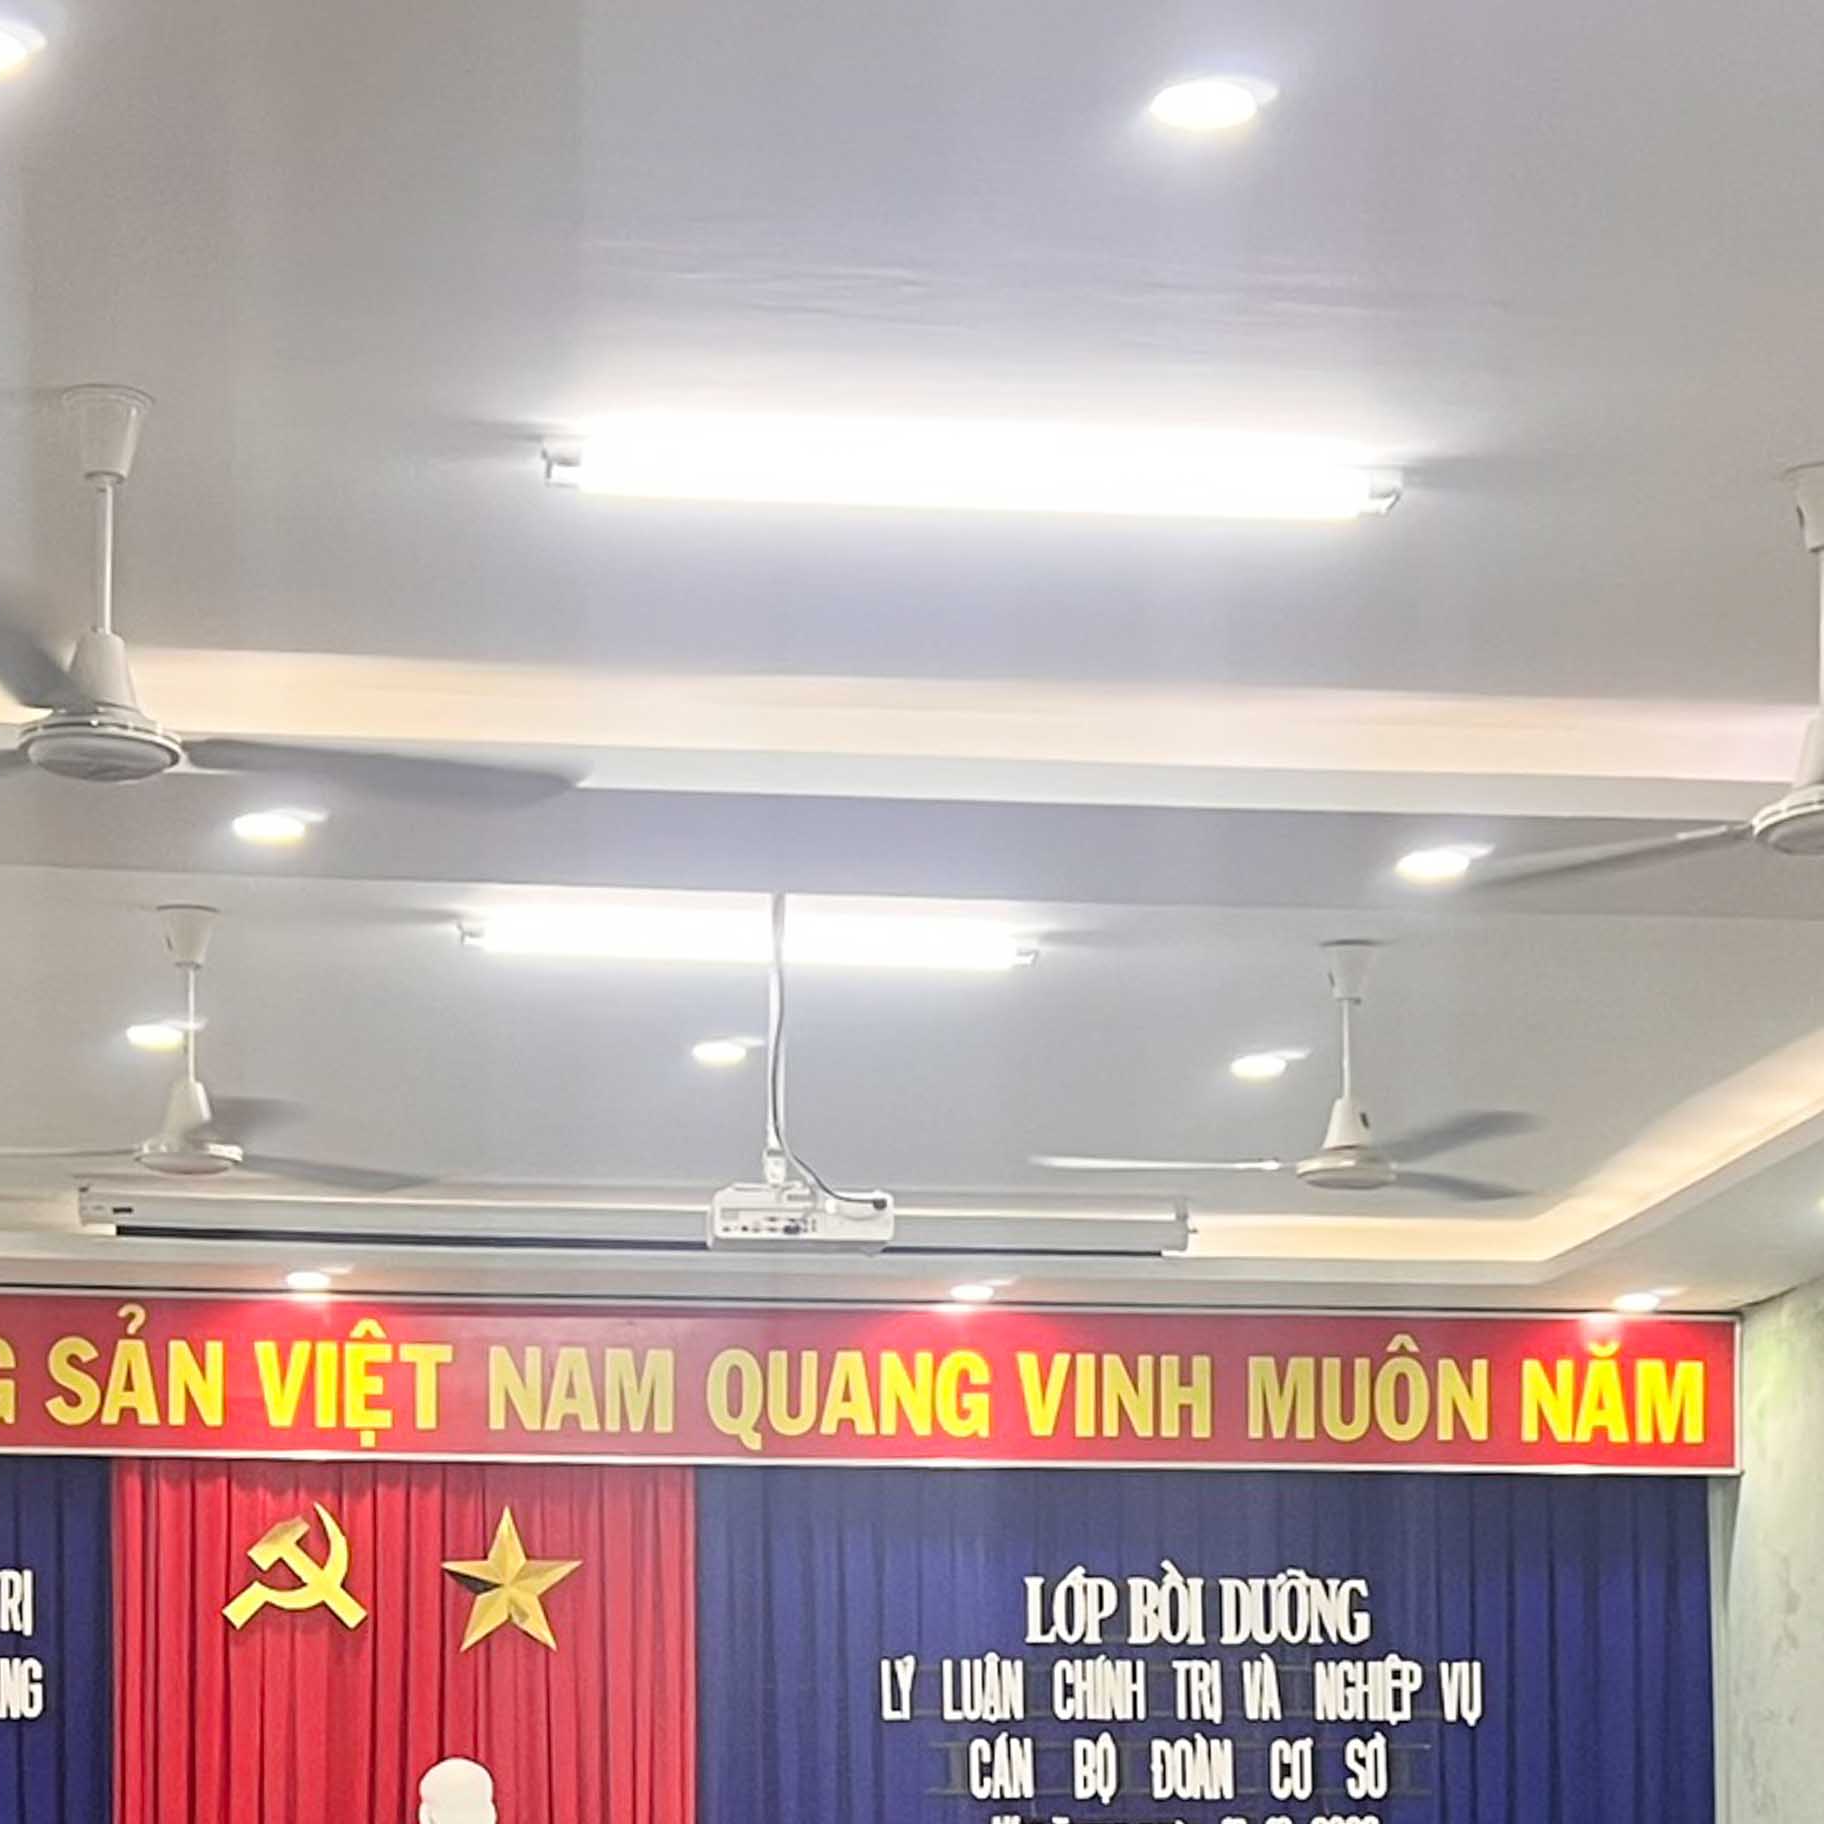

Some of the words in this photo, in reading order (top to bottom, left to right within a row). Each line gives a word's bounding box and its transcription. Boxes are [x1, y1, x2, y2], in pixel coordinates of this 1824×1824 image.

[46, 1305, 228, 1427] SẢN
[254, 1317, 456, 1449] VIỆT
[489, 1346, 674, 1433] NAM
[708, 1346, 994, 1452] QUANG
[1013, 1351, 1213, 1441] VINH
[1248, 1335, 1491, 1443] MUÔN
[1520, 1340, 1706, 1446] NĂM
[1023, 1564, 1119, 1645] LỚP
[1217, 1567, 1372, 1646] DƯỠNG
[879, 1653, 917, 1722] LÝ
[941, 1651, 1025, 1724] LUẬN
[1052, 1653, 1147, 1722] CHÍNH
[1170, 1658, 1223, 1725] TRỊ
[1241, 1652, 1283, 1722] VÀ
[1313, 1653, 1423, 1727] NGHIỆP
[1438, 1660, 1483, 1728] VỤ
[968, 1731, 1036, 1800] CÁN
[1072, 1731, 1118, 1806] BỘ
[1149, 1731, 1235, 1801] ĐOÀN
[1269, 1736, 1315, 1801] CƠ
